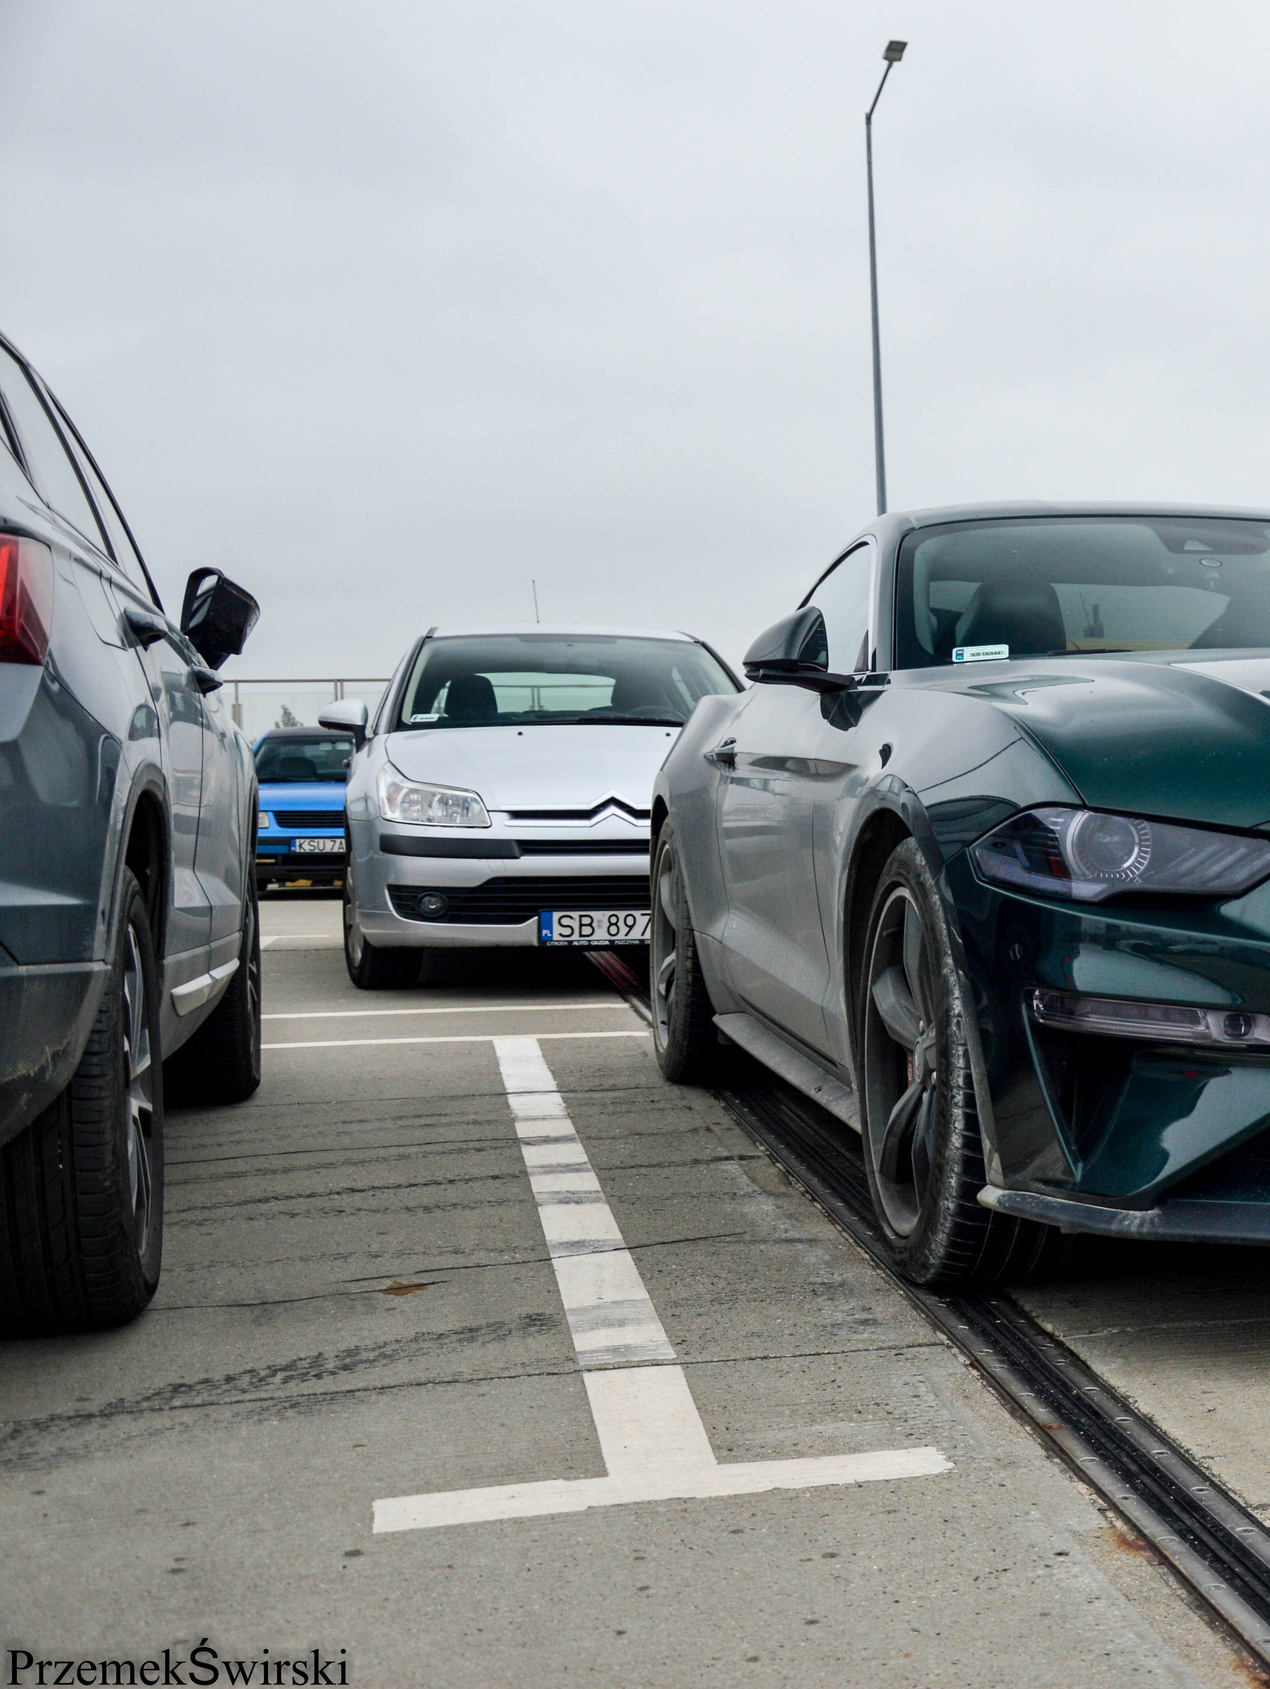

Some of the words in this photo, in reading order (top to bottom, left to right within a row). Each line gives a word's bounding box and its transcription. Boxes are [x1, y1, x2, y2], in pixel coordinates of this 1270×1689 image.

[298, 840, 326, 852] KSU
[557, 914, 595, 938] SB
[607, 912, 652, 937] 897
[542, 929, 552, 937] PL
